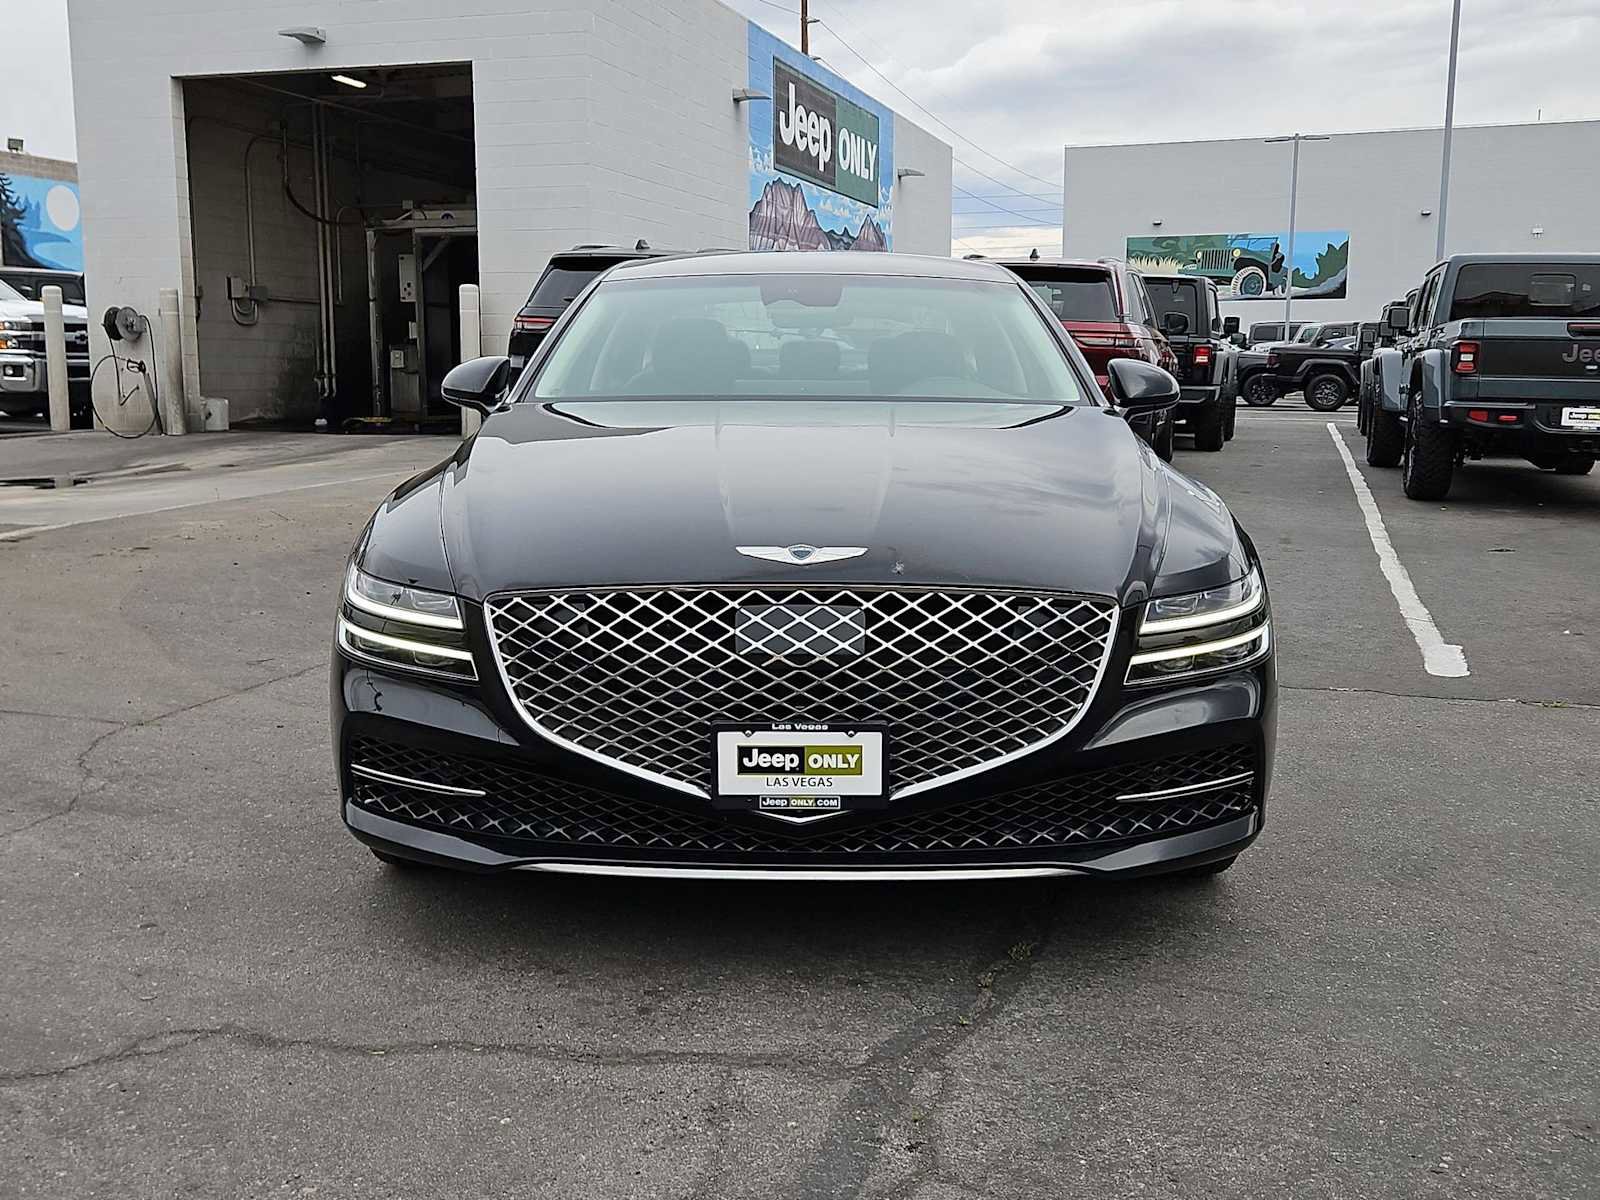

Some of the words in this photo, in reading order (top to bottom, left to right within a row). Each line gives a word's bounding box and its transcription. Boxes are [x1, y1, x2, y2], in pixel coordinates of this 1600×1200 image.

[779, 82, 832, 171] Jeep
[838, 127, 877, 182] ONLY
[742, 748, 800, 771] Jeep
[808, 753, 860, 769] ONLY
[766, 777, 788, 787] LAS
[791, 777, 833, 787] VEGAS
[762, 797, 788, 807] Jeep
